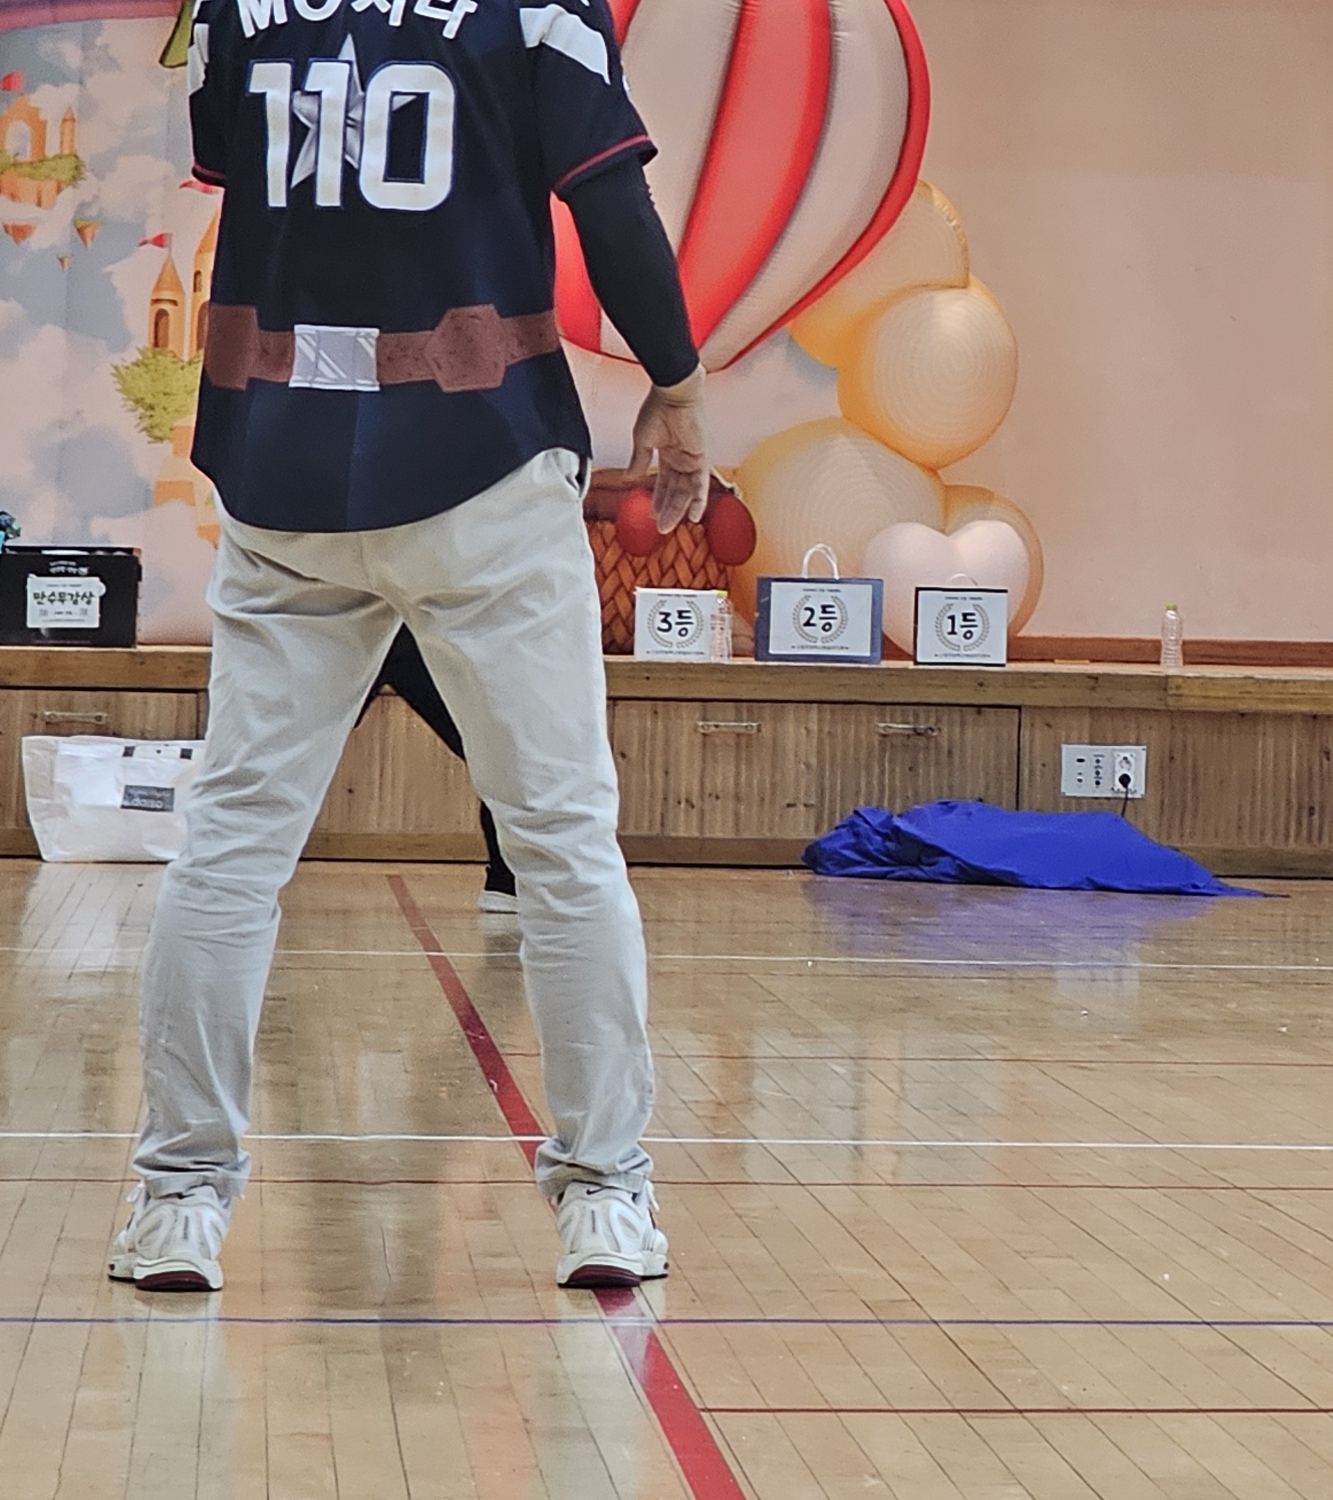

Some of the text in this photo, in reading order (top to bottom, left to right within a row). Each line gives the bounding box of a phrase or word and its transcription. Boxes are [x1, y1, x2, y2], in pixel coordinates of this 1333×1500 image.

[248, 60, 456, 212] 110
[32, 591, 96, 605] 만수무강상
[656, 609, 694, 637] 3등
[802, 604, 838, 633] 2등
[946, 611, 978, 640] 1등
